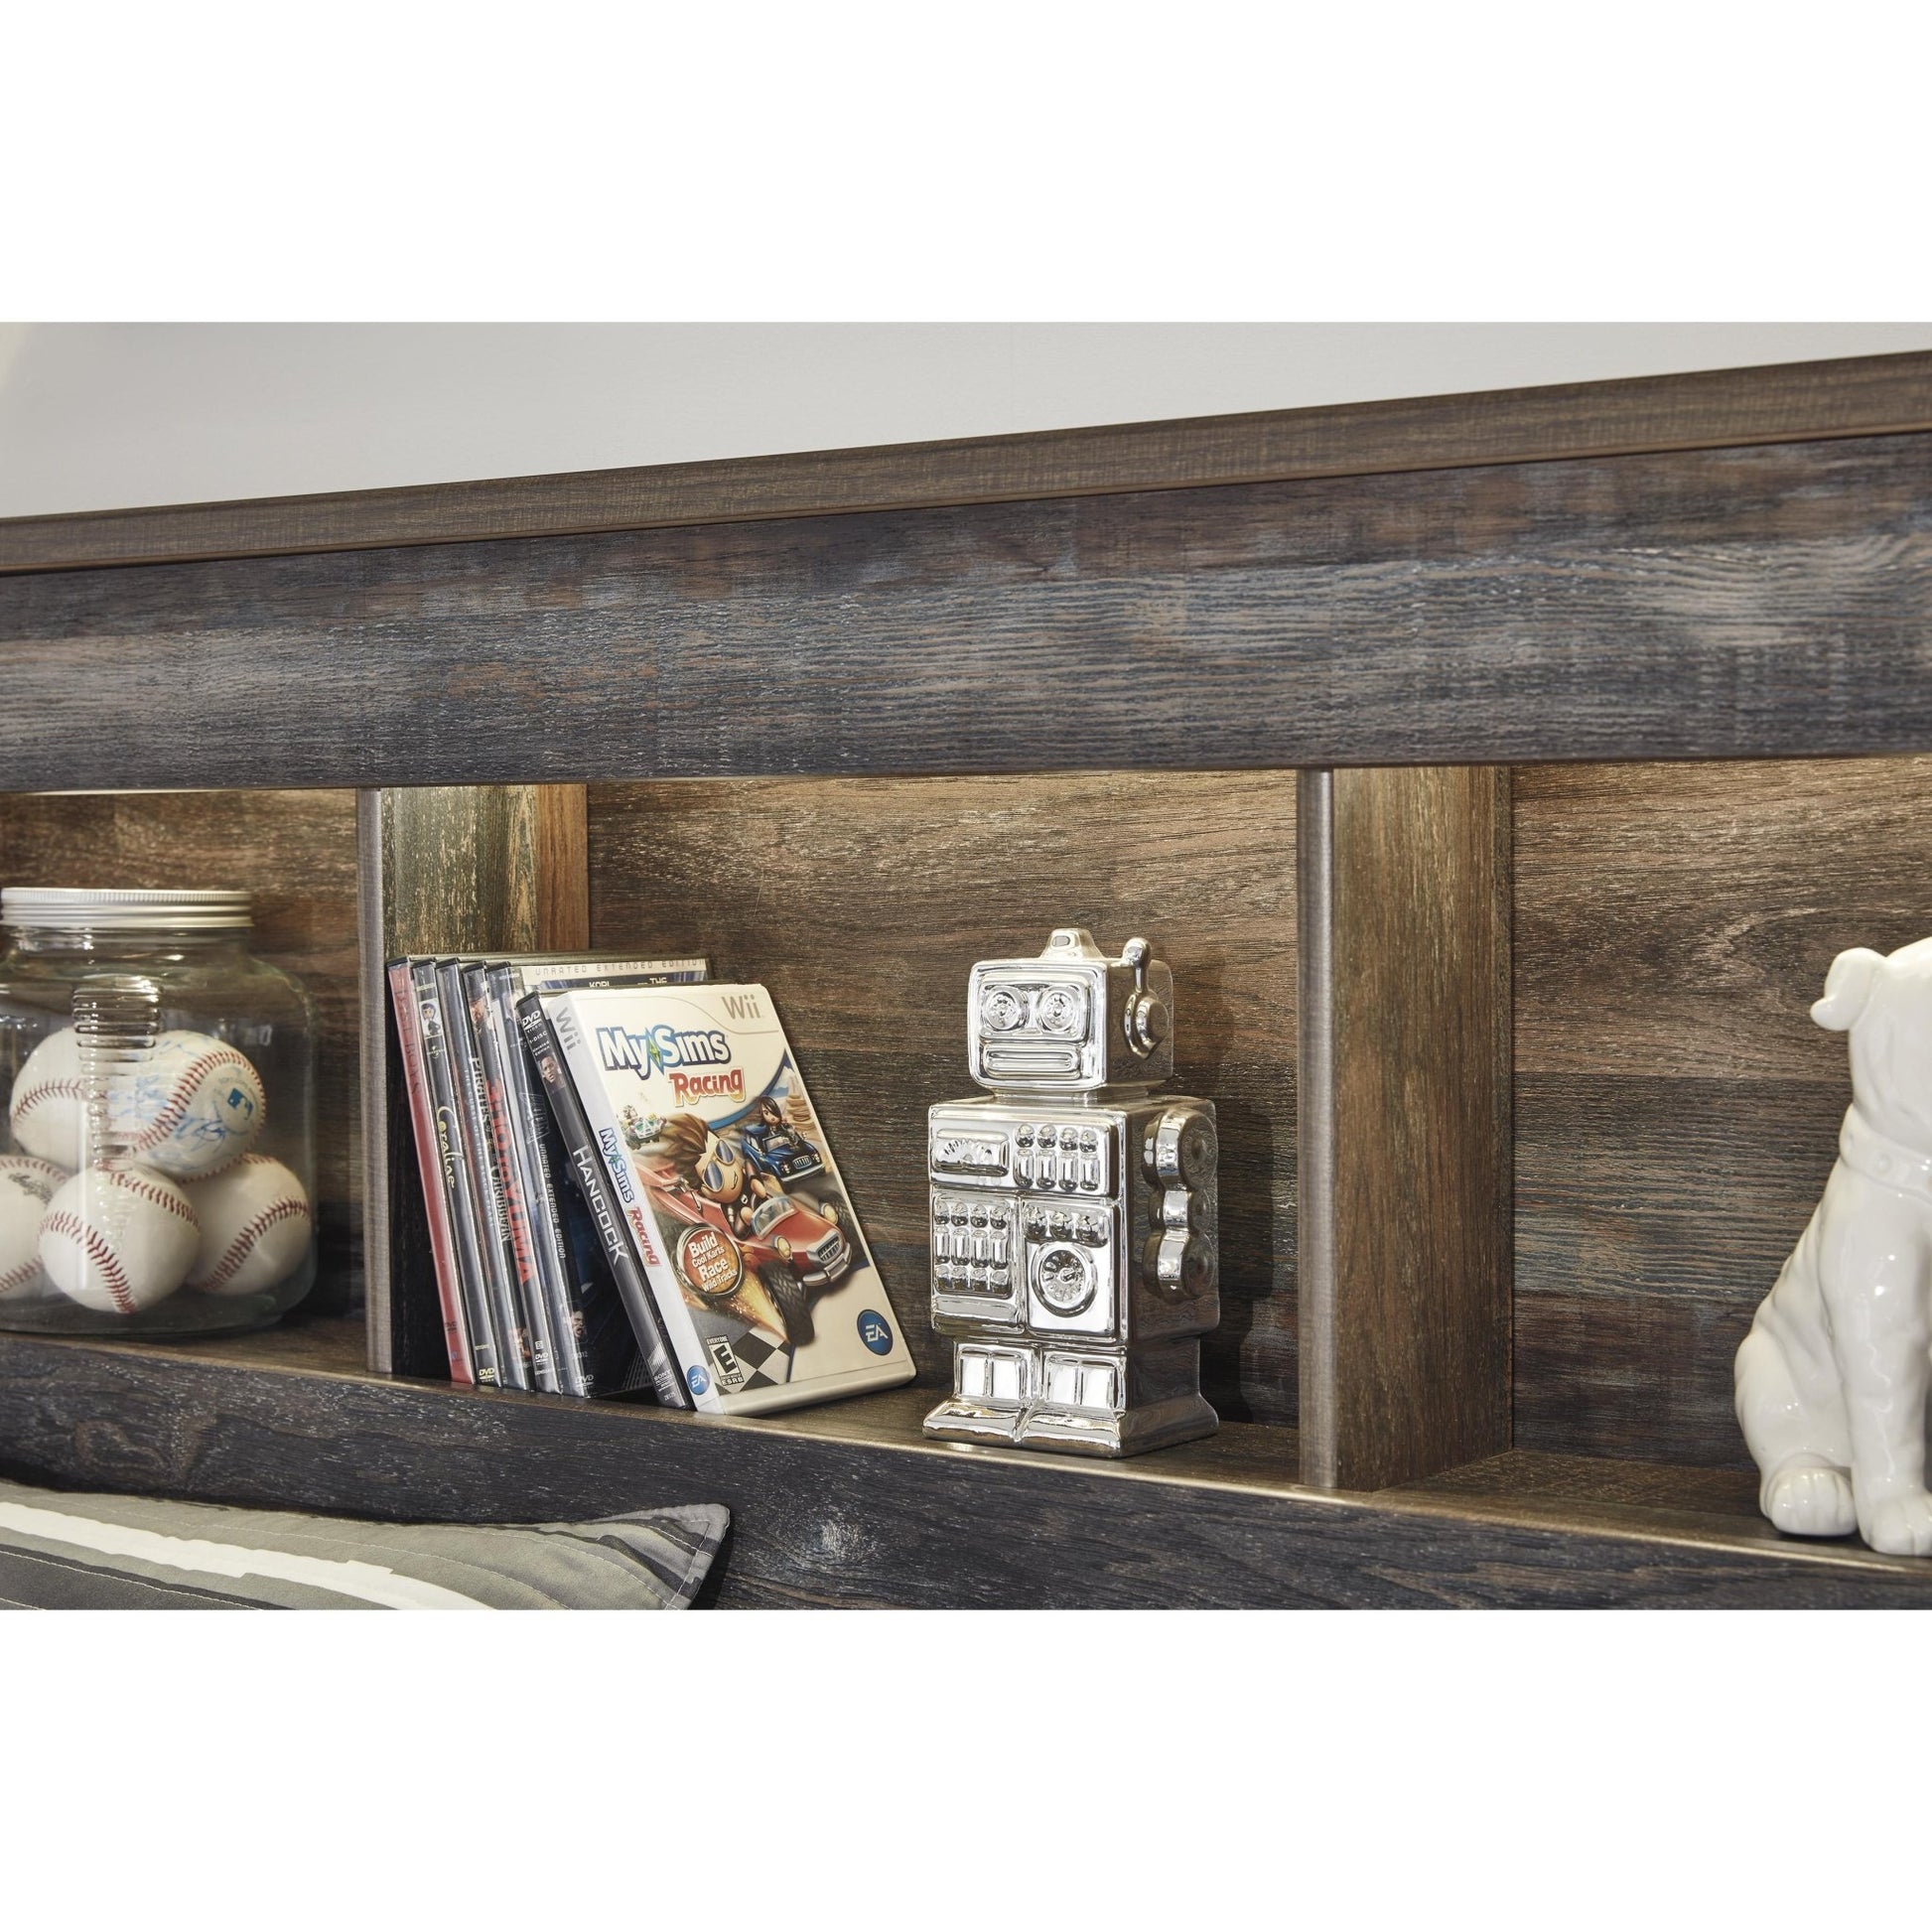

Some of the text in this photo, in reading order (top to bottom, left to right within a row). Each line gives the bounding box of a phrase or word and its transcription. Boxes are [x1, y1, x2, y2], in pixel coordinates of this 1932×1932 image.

[535, 966, 587, 976] UNRATED
[597, 961, 653, 972] EXTENDED
[521, 1010, 541, 1026] DVD
[721, 994, 761, 1020] Wii
[556, 1007, 582, 1050] Wii
[469, 1057, 490, 1123] PIRATES
[668, 1067, 746, 1107] Racing
[437, 1106, 464, 1188] Coraline
[490, 1166, 512, 1242] CARIBBEAN
[539, 1144, 566, 1259] UNRATED EXTENDED EDITION
[573, 1145, 628, 1265] HANCOCK
[625, 1205, 661, 1267] Racing
[688, 1231, 719, 1258] Build
[692, 1246, 726, 1268] Cool Karts
[698, 1258, 729, 1282] Race
[702, 1278, 718, 1292] Wild
[706, 1335, 729, 1345] EVERYONE
[866, 1323, 889, 1342] EA
[479, 1367, 494, 1376] DVD
[713, 1344, 737, 1374] E
[691, 1373, 707, 1388] EA
[722, 1376, 744, 1386] ESRB
